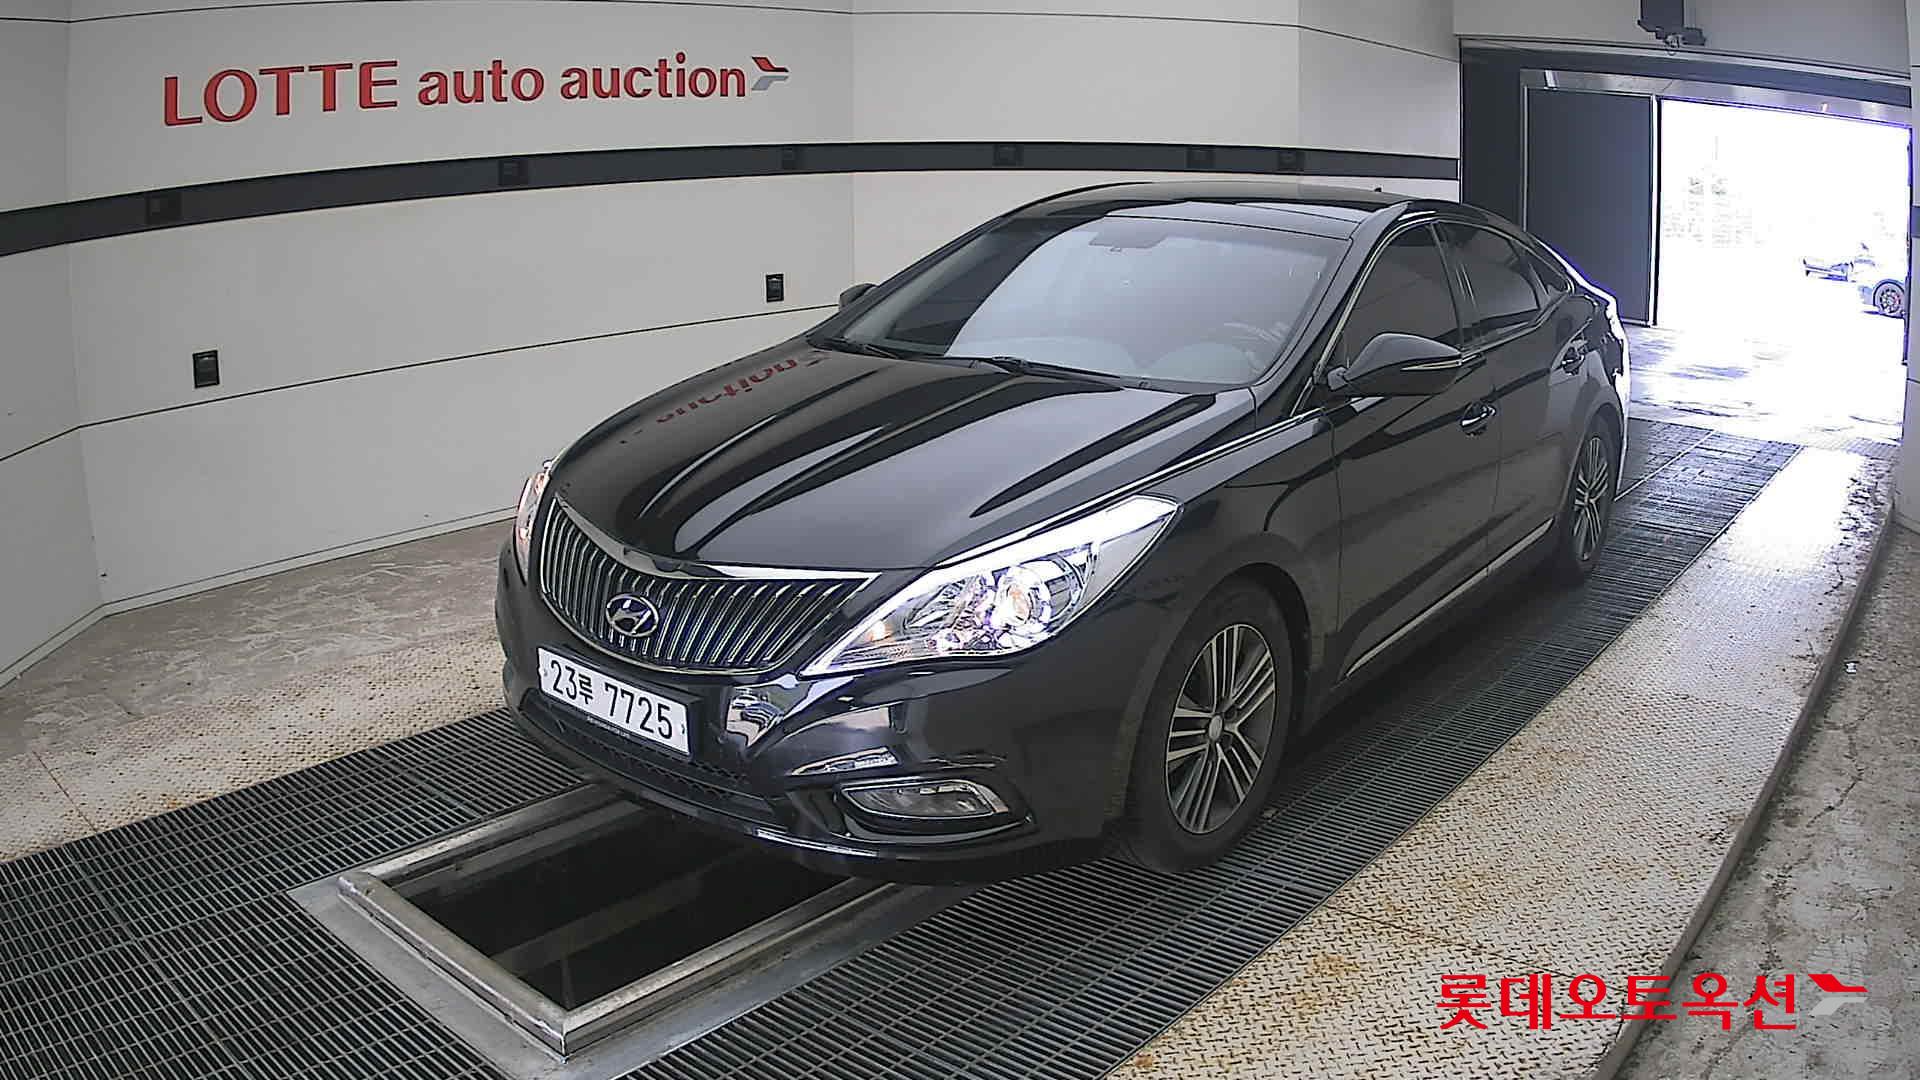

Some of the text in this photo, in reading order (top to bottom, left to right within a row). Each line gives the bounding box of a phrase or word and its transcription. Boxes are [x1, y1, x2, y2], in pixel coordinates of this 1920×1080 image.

[163, 52, 747, 126] LOTTE auto auction
[550, 659, 594, 705] 23루
[604, 682, 673, 740] 7725
